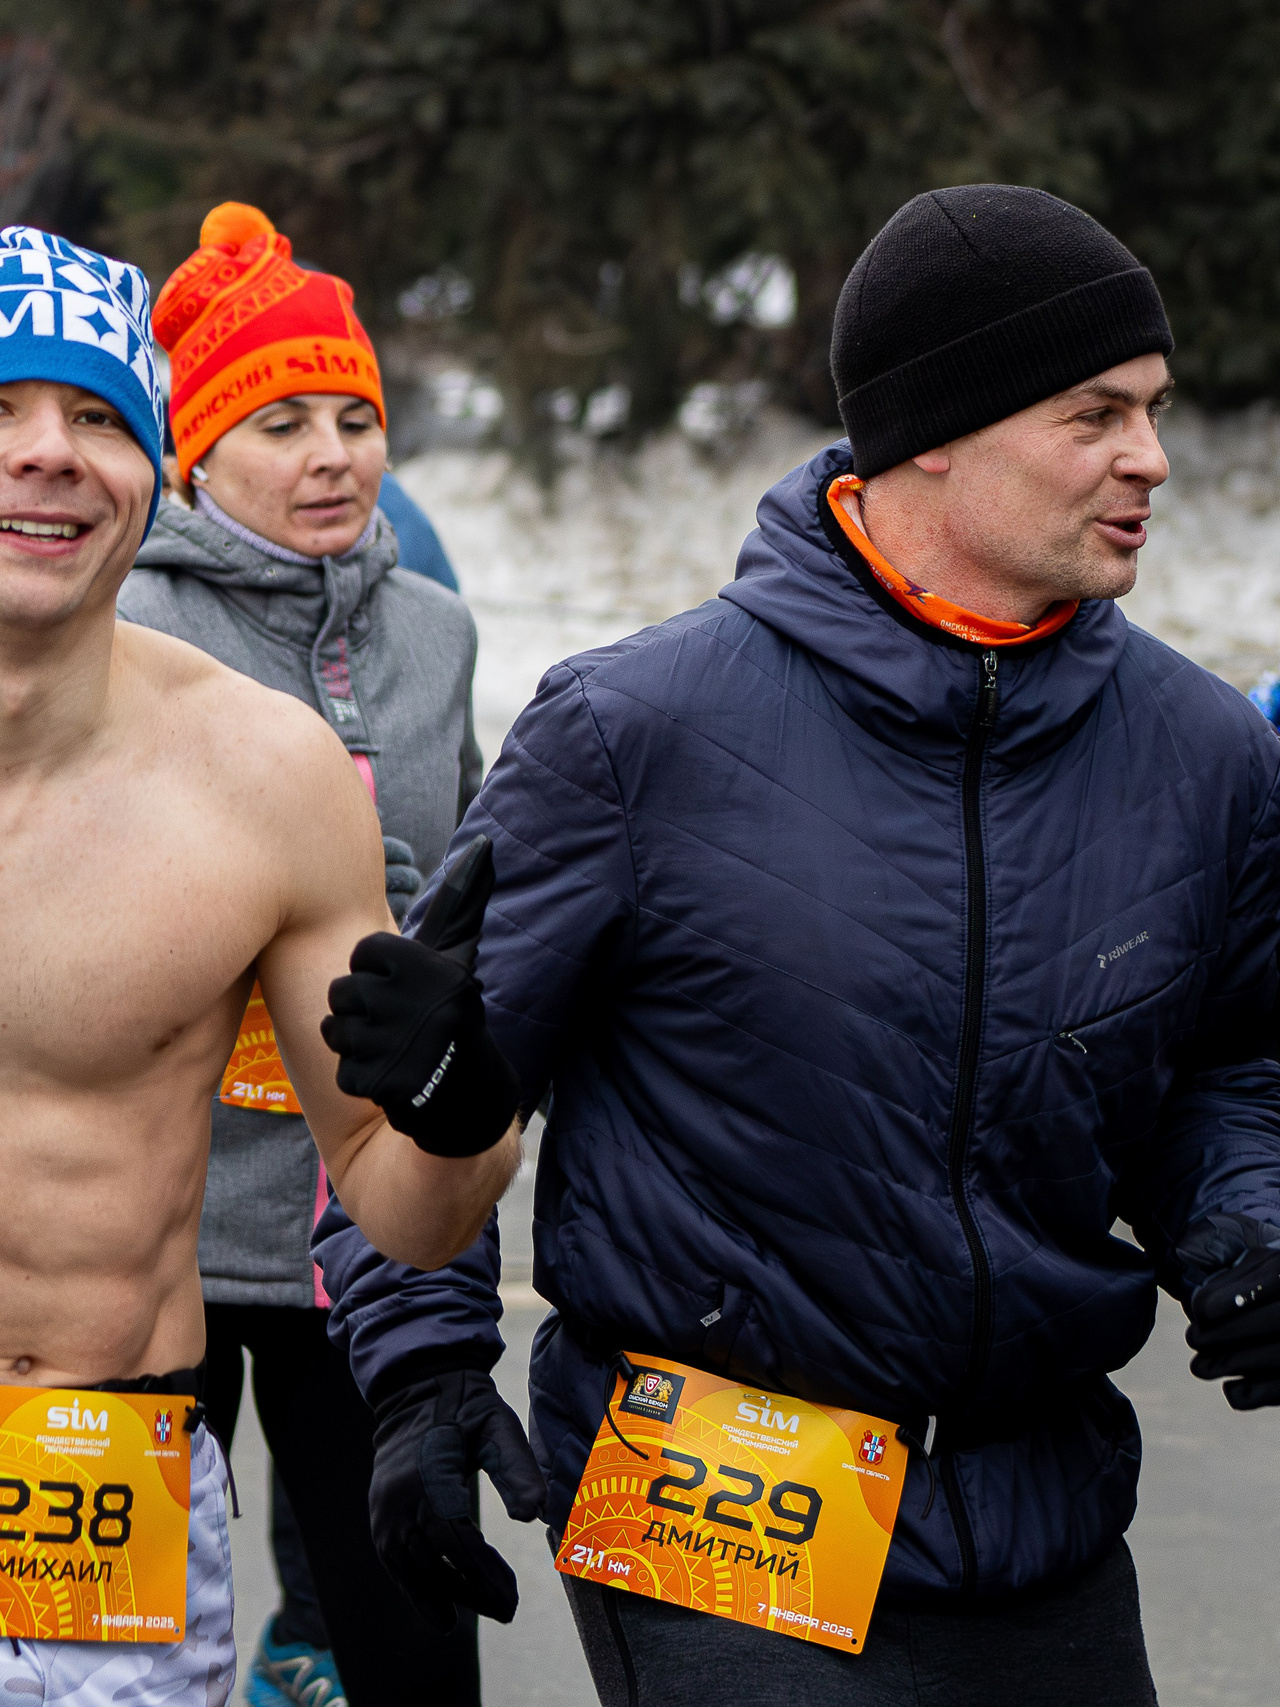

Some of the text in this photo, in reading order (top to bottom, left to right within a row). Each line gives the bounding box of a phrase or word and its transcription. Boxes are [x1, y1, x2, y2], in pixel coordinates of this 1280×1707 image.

[721, 1423, 799, 1449] РОЖДЕСТВЕНСКИЙ
[727, 1434, 791, 1456] ПОЛУМАРАФОН
[645, 1447, 824, 1546] 229
[641, 1519, 801, 1581] ДМИТРИЙ
[92, 1613, 175, 1629] 7 ЯНВАРЯ 2025
[757, 1602, 854, 1638] 7 ЯНВАРЯ 2025
